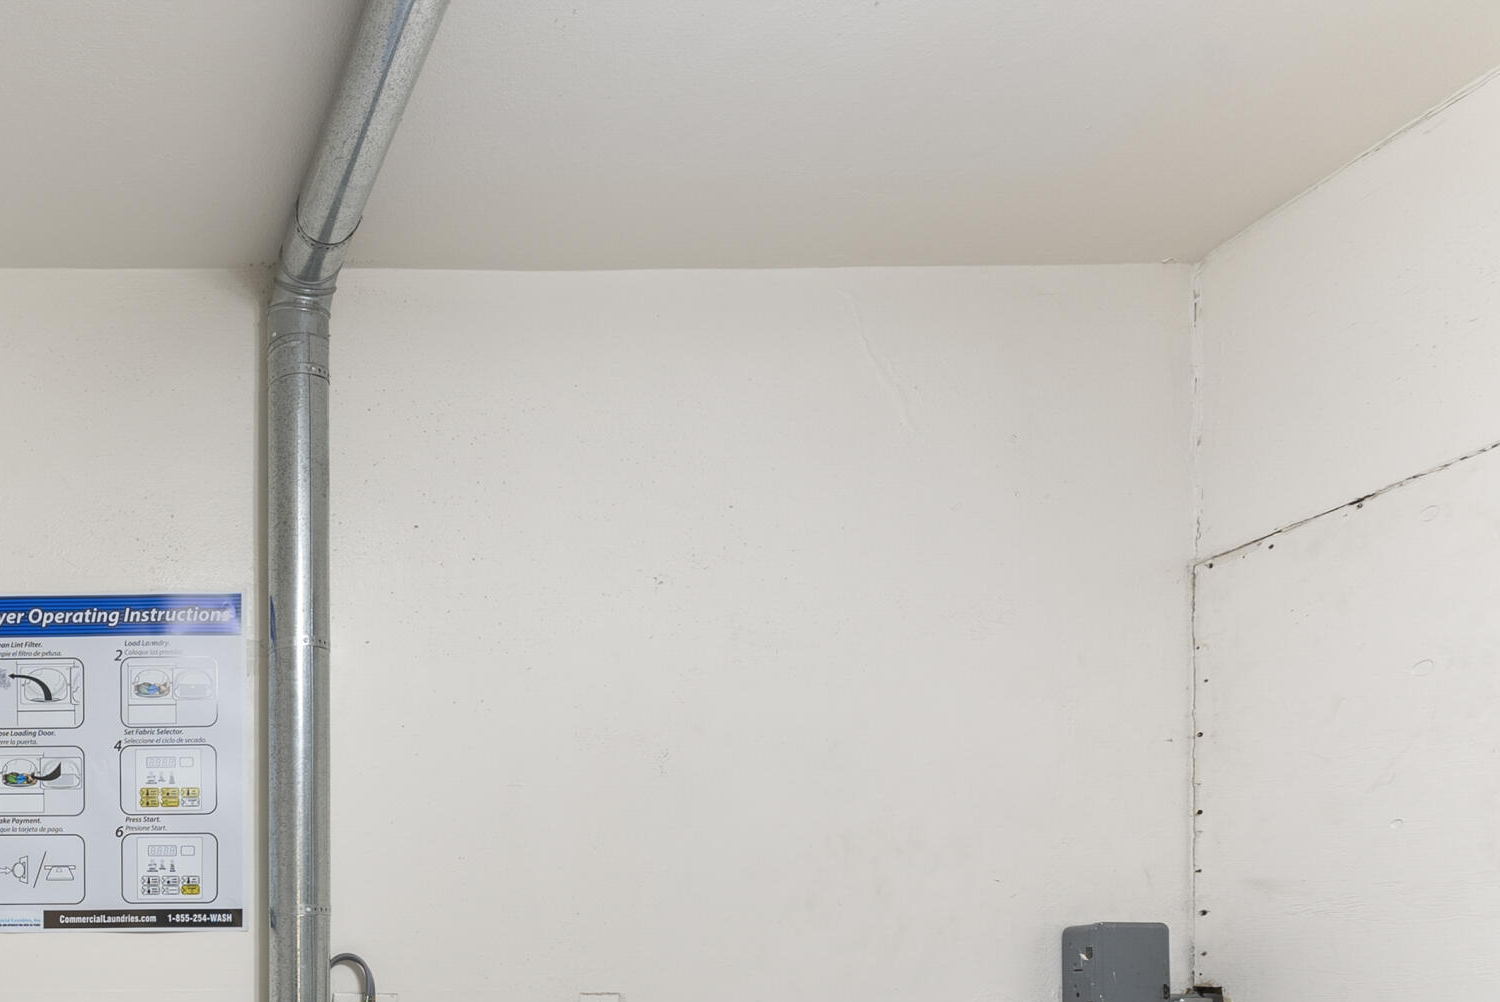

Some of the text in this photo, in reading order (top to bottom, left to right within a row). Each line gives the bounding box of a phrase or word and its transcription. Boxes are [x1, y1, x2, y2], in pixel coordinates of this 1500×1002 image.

[28, 608, 119, 628] Operating
[124, 606, 230, 622] Instructions
[114, 649, 122, 661] 2
[114, 740, 122, 751] 4
[116, 826, 123, 837] 6
[60, 914, 232, 924] CommercialLaundries.com 1-855-254-WASH
